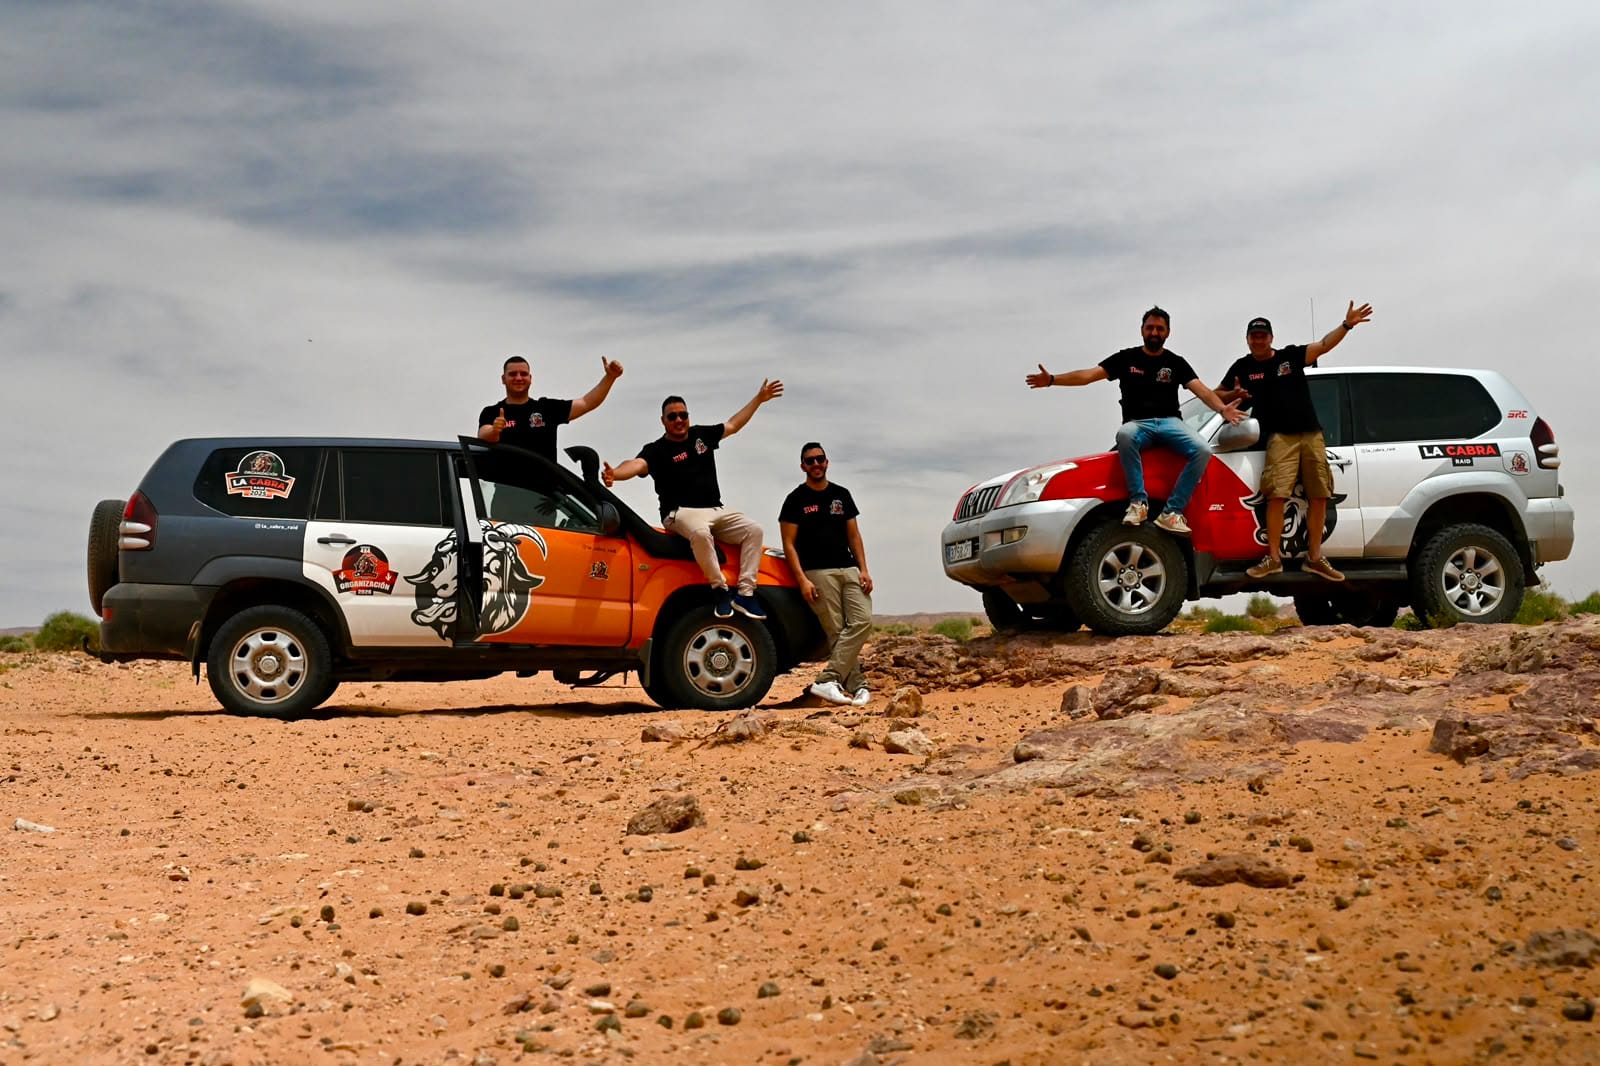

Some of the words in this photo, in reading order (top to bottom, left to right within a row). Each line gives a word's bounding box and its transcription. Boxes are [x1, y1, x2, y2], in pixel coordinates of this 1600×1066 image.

[1422, 446, 1444, 457] LA
[1446, 445, 1497, 456] CABRA
[232, 478, 248, 487] LA
[249, 478, 287, 490] CABRA
[803, 505, 819, 513] STAFF
[339, 580, 391, 591] ORGANIZACIÓN
